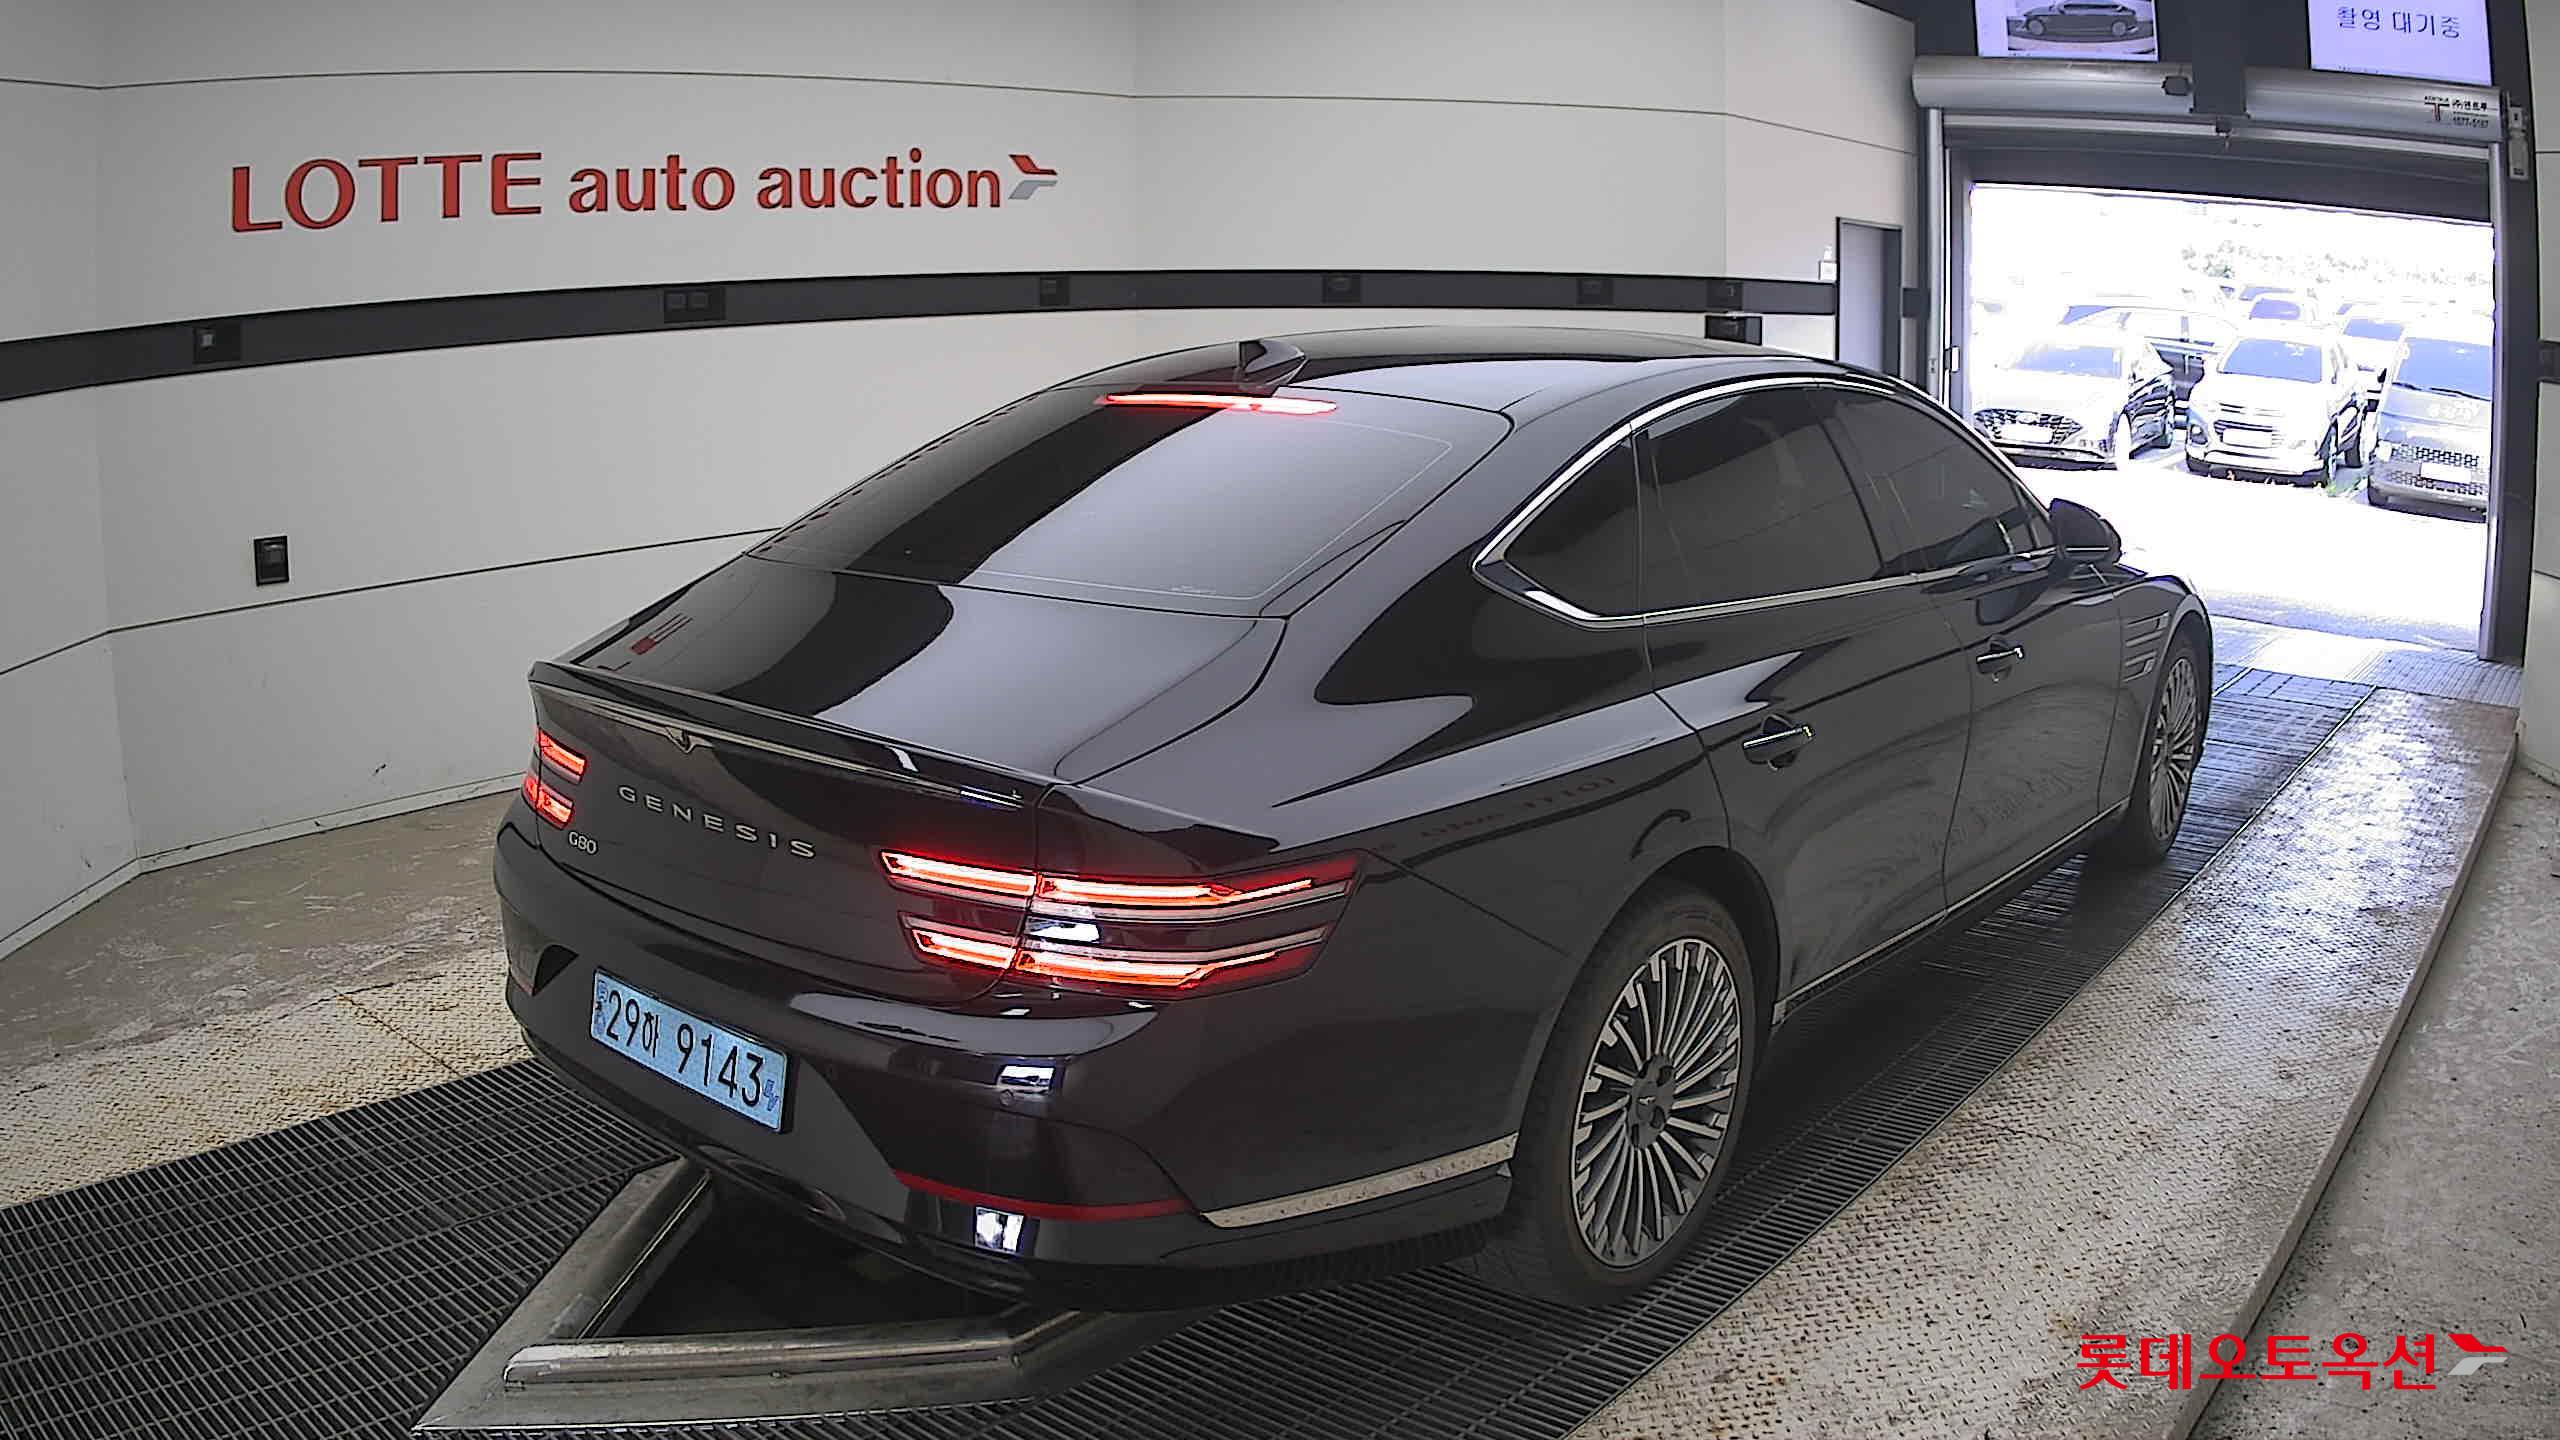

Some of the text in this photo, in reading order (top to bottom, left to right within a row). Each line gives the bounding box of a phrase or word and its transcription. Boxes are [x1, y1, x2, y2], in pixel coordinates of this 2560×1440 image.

[2337, 6, 2460, 38] 촬영 대기중
[232, 147, 1002, 232] LOTTE auto auction
[568, 830, 598, 855] G80
[618, 785, 816, 859] GENESIS
[606, 990, 766, 1107] 29하 9143
